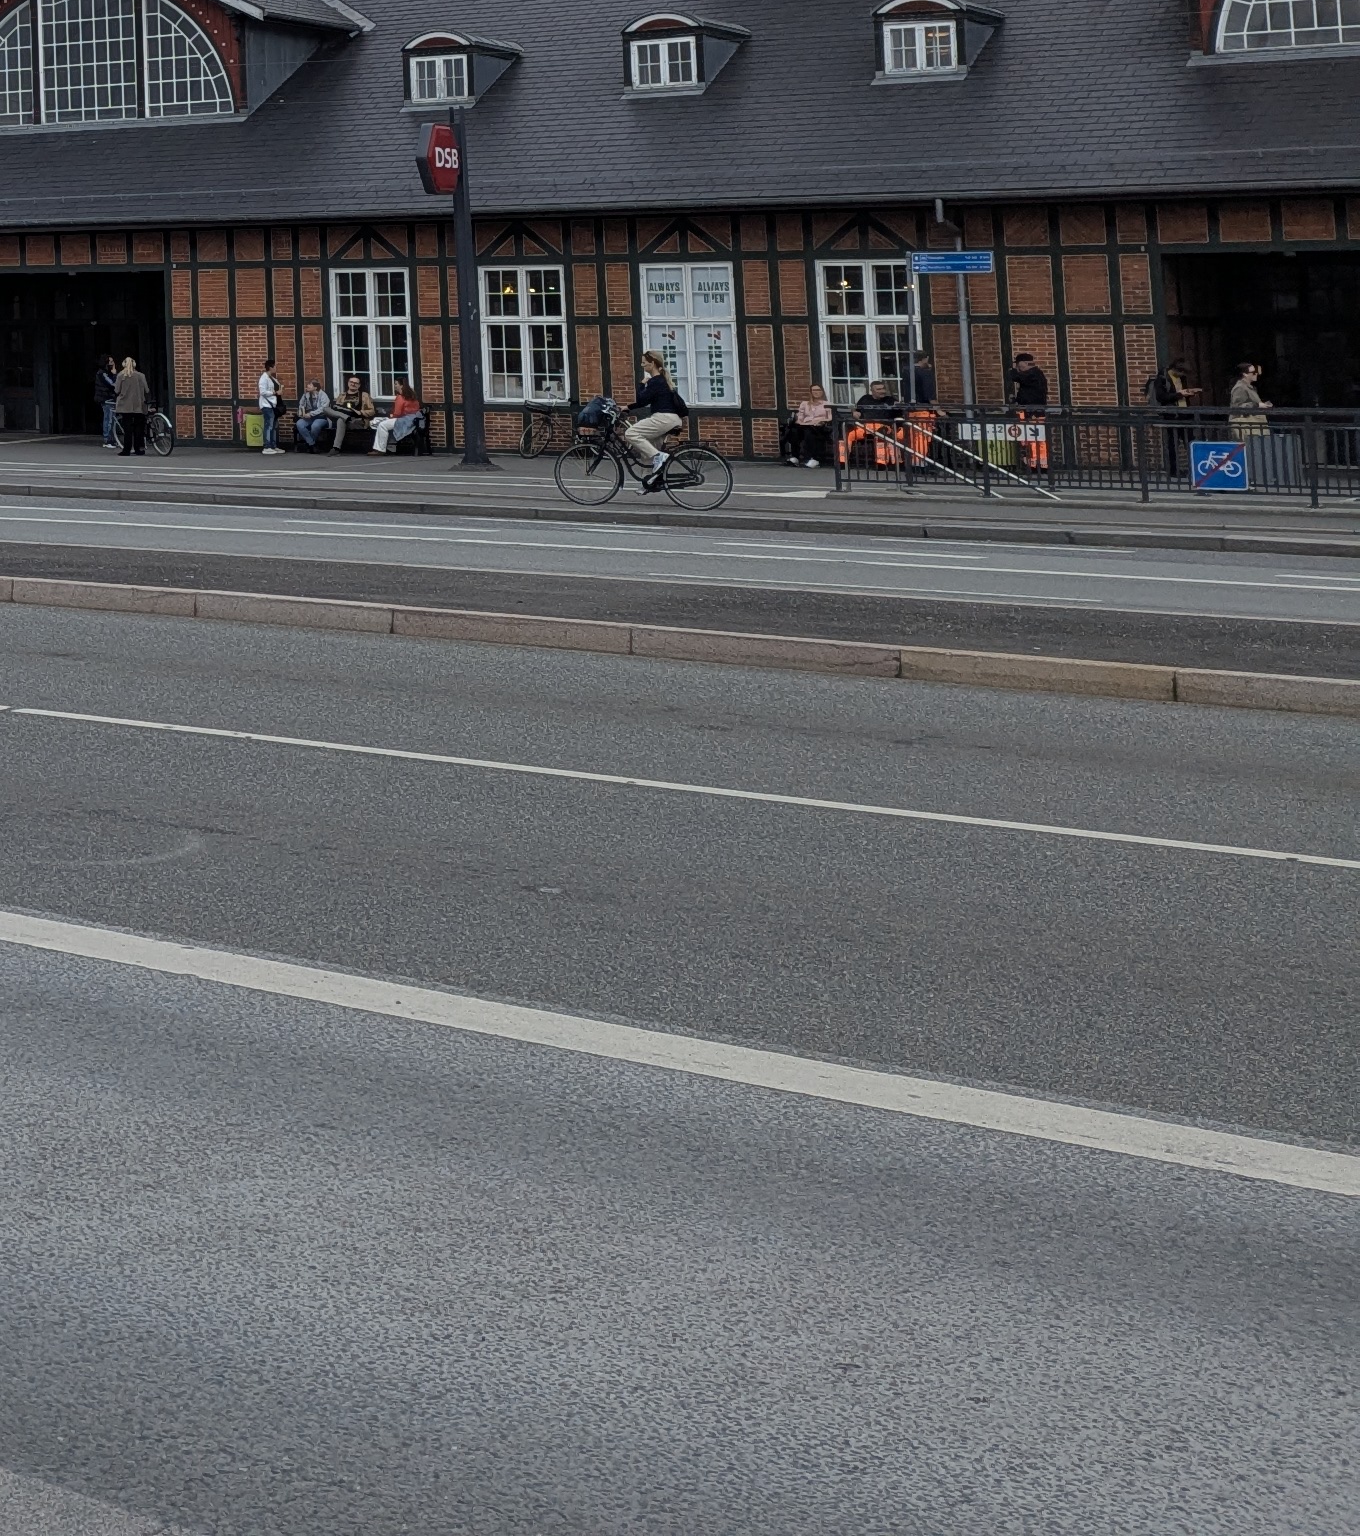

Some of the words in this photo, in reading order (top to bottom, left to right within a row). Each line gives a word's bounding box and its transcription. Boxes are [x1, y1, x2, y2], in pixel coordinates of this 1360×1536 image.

[435, 146, 459, 169] DSB
[649, 282, 681, 292] ALWAYS
[698, 282, 730, 292] ALWAYS
[655, 293, 676, 304] OPEN
